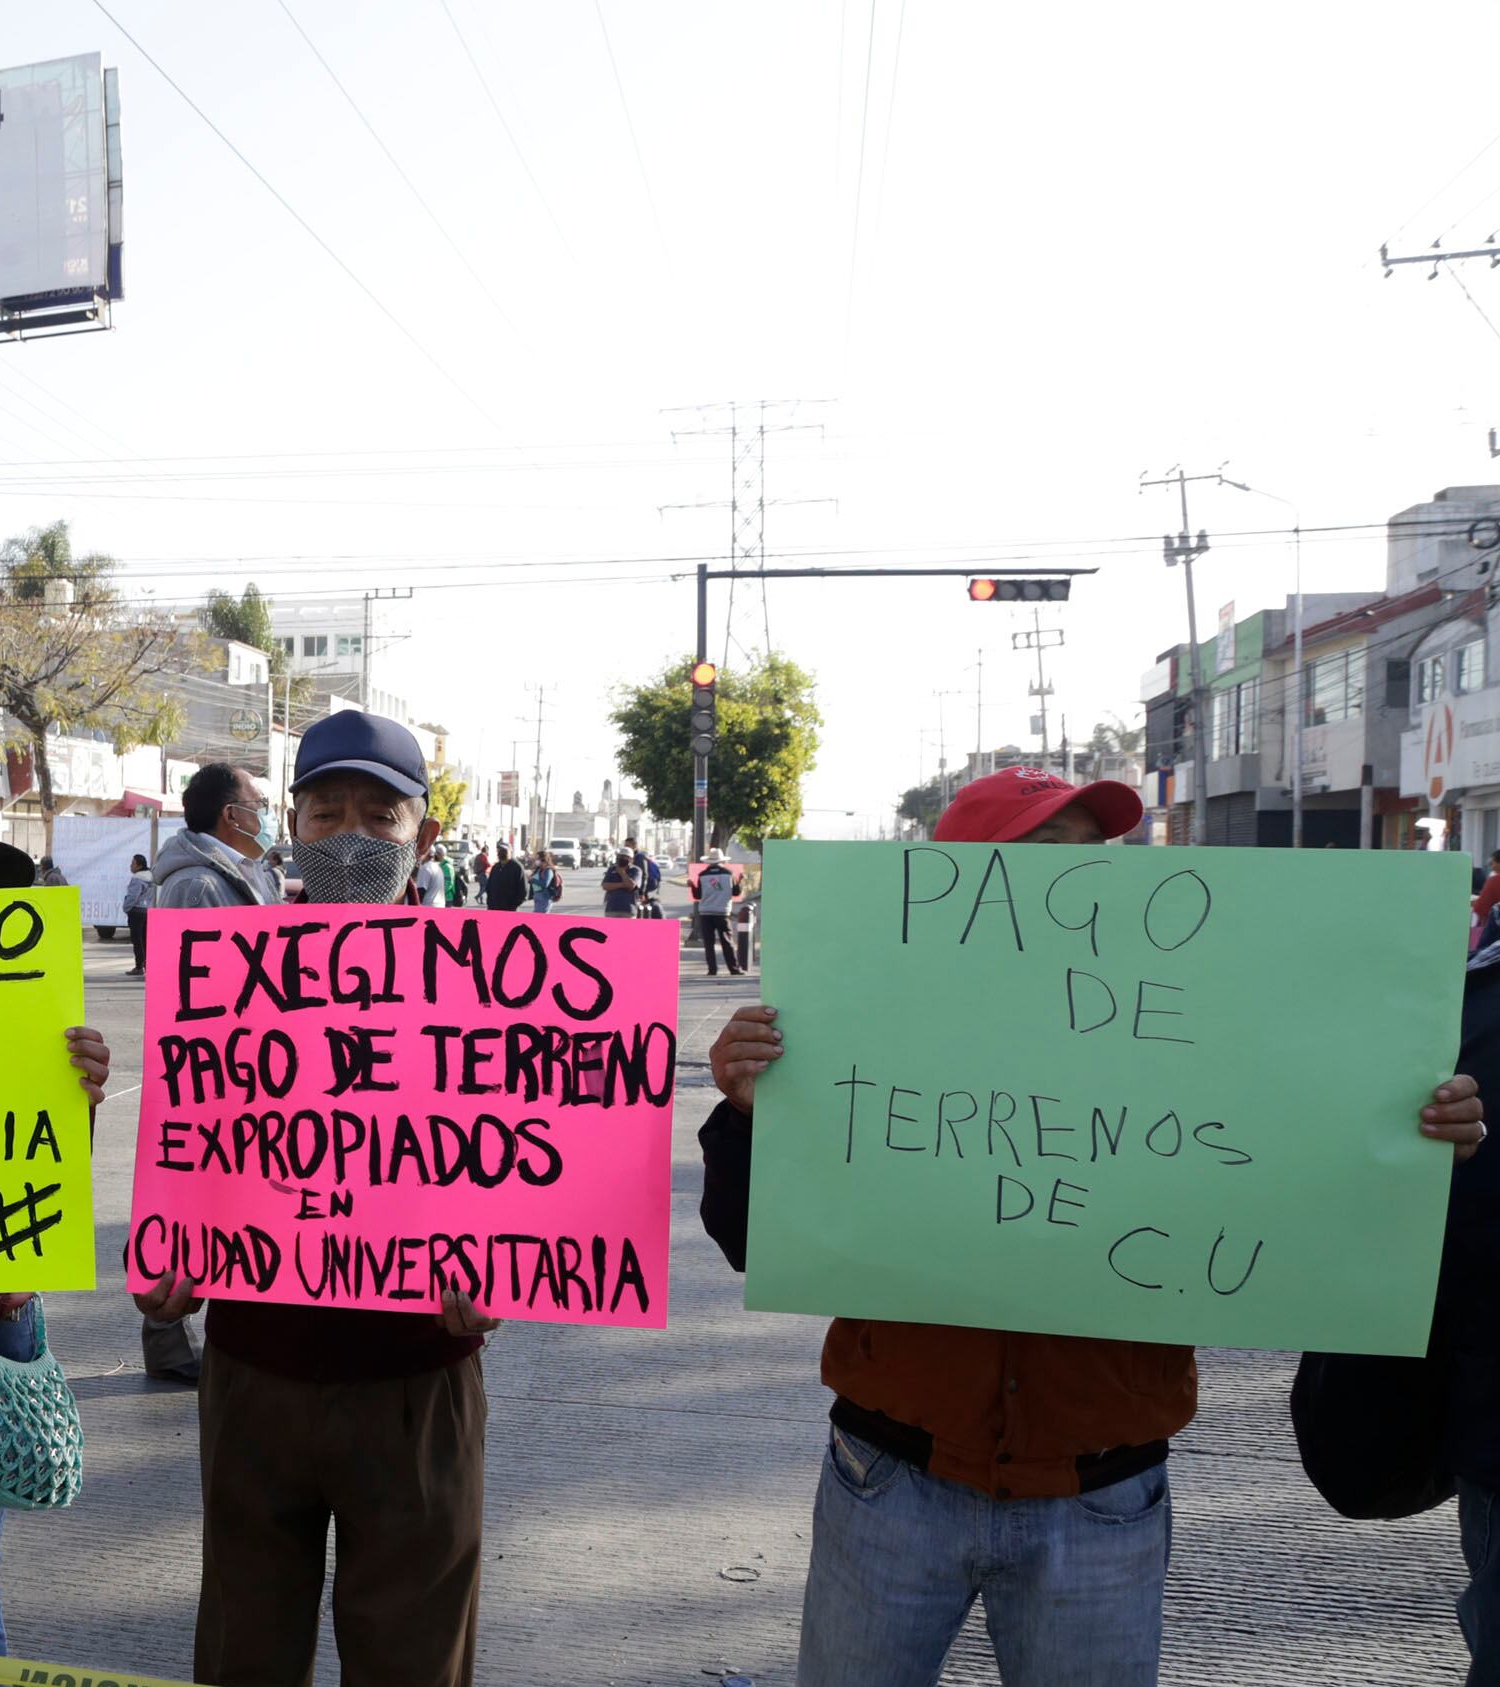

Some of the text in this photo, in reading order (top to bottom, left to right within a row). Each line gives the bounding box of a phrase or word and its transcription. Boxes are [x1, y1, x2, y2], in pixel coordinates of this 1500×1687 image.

[901, 847, 1211, 957] PAGO
[1066, 967, 1195, 1044] DE
[158, 1022, 677, 1108] PAGO DE TERRENO
[156, 1109, 563, 1188] EXPROPIADOS
[834, 1064, 1253, 1166] TERRENOS
[294, 1189, 353, 1220] EN
[996, 1174, 1089, 1227] DE
[134, 1214, 650, 1313] CIUDAD UNIVERSITARIA
